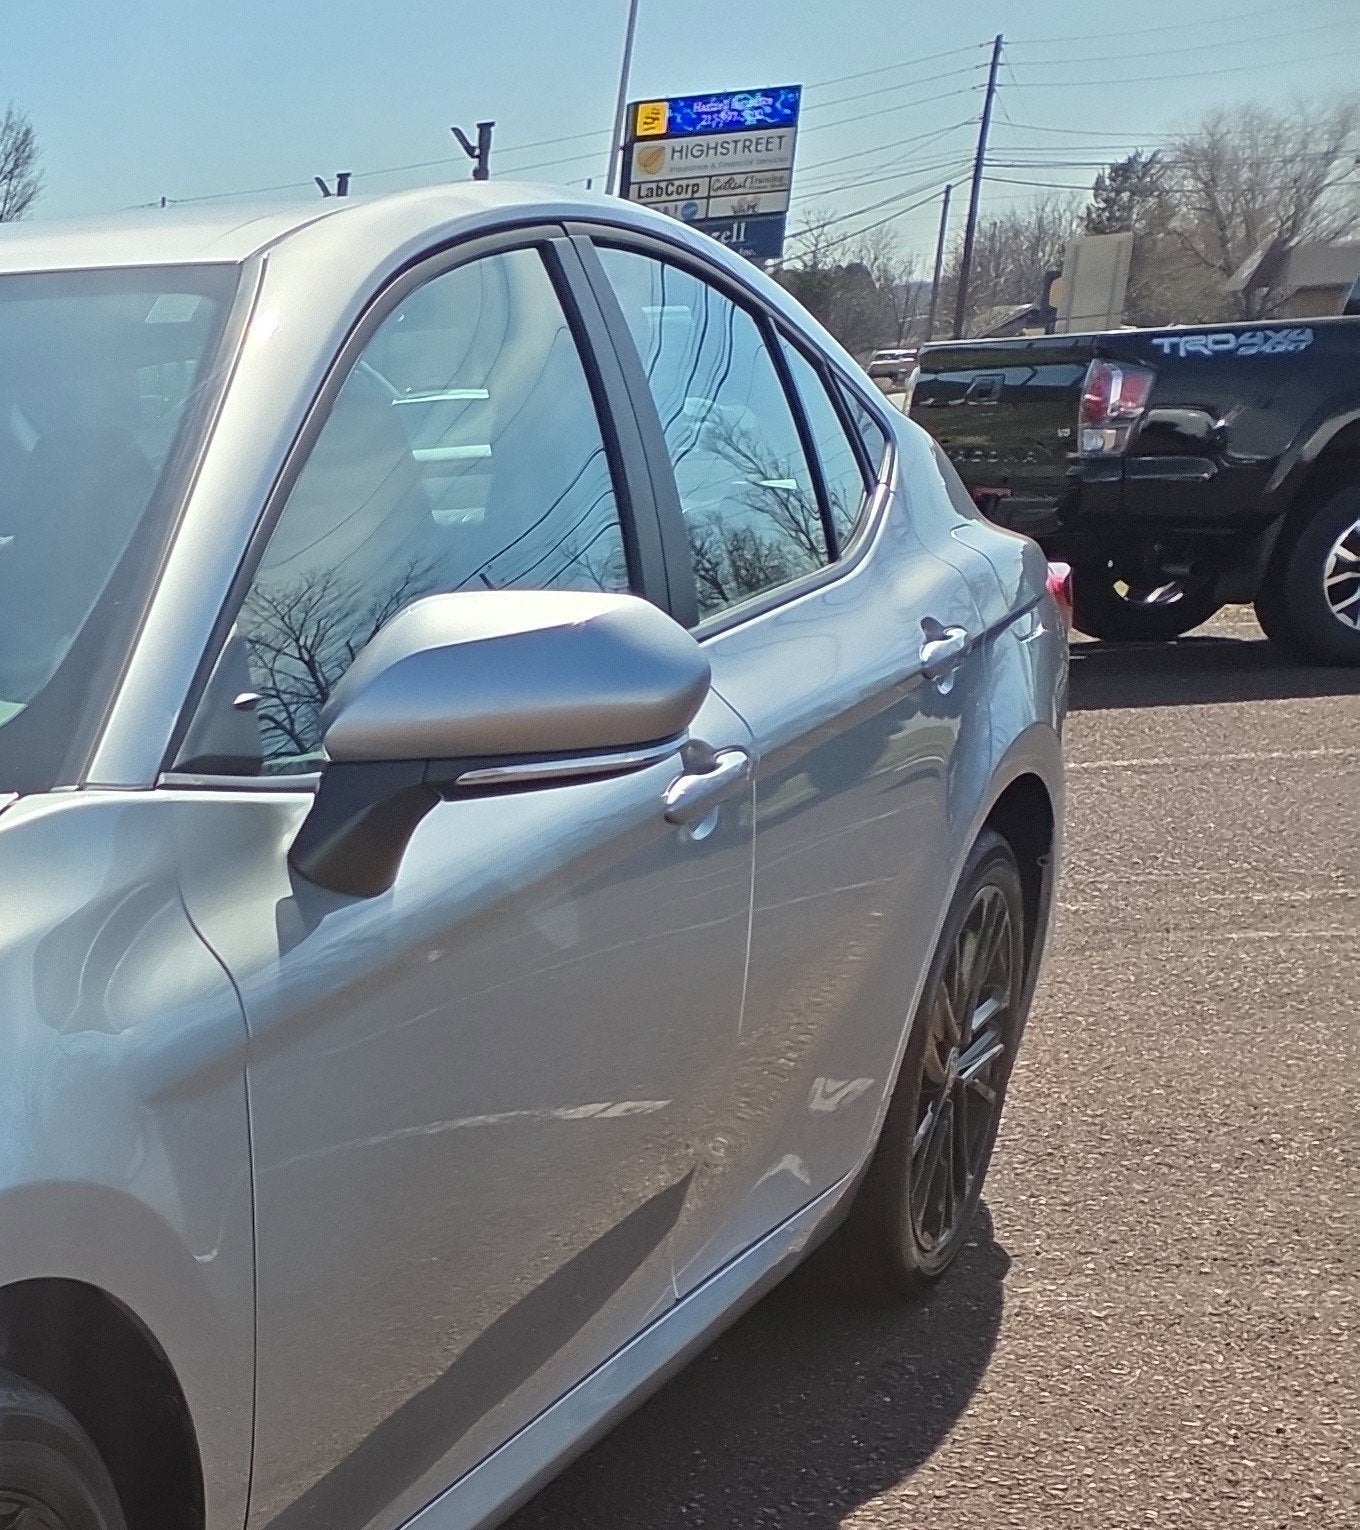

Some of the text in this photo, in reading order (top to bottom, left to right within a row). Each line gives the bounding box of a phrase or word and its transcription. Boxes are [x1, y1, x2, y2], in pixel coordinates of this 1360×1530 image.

[670, 135, 786, 161] HIGHSTREET
[637, 181, 700, 200] LabCorp
[1152, 333, 1237, 357] TRD
